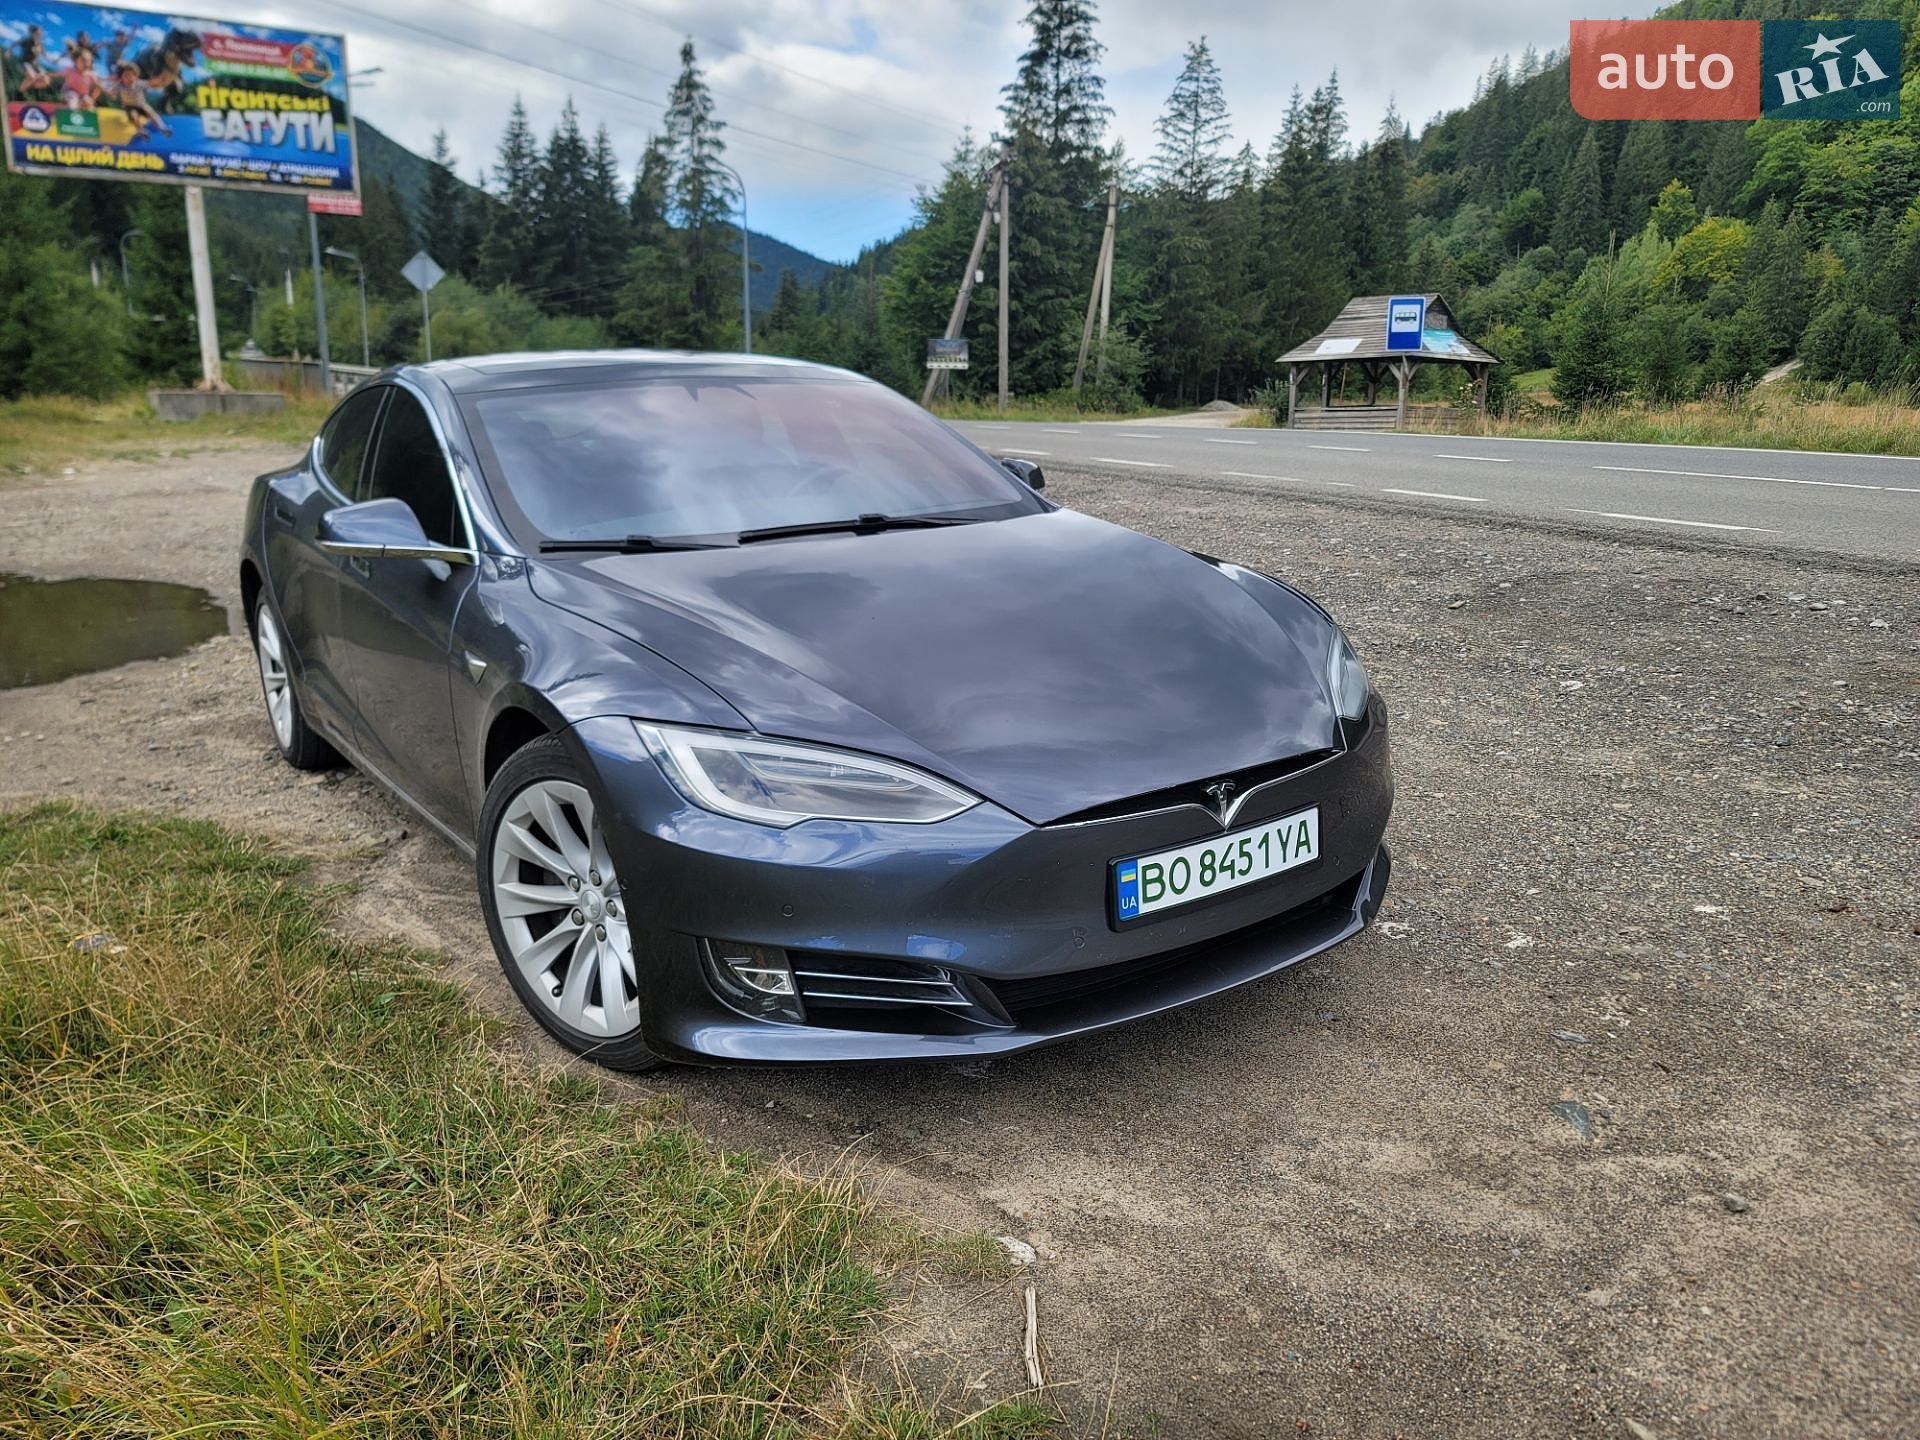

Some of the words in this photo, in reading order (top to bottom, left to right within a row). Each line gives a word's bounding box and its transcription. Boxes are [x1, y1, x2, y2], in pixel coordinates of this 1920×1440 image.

[202, 109, 336, 153] БАТУТИ
[26, 143, 54, 162] НА
[1141, 856, 1191, 904] BO
[1199, 831, 1270, 887] 8451
[1277, 819, 1312, 863] YA
[1121, 896, 1138, 911] UA
